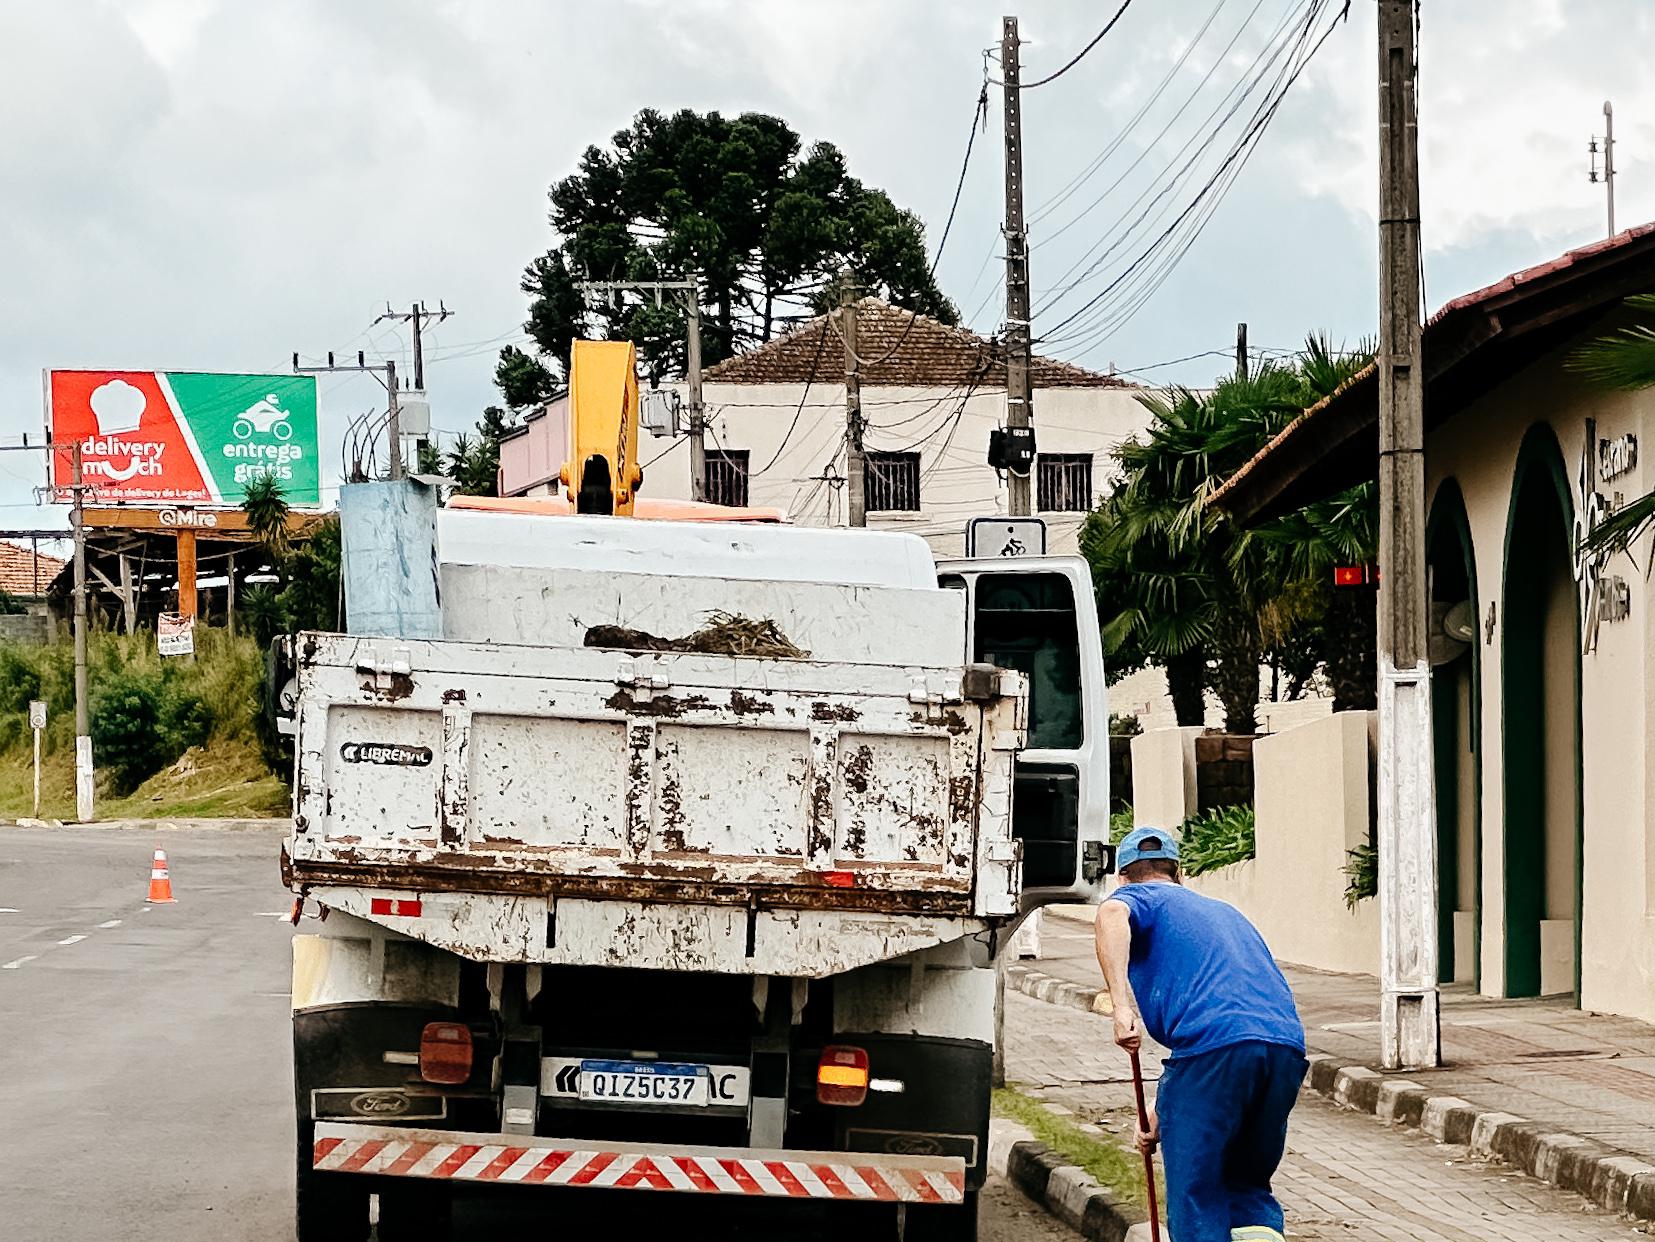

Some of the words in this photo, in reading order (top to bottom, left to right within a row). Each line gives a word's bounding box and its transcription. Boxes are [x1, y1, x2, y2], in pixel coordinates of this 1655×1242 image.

[81, 435, 166, 460] delivery
[222, 441, 303, 464] entrega
[82, 456, 163, 481] much
[593, 1074, 696, 1100] QIZ5C37
[362, 1096, 402, 1112] Ford
